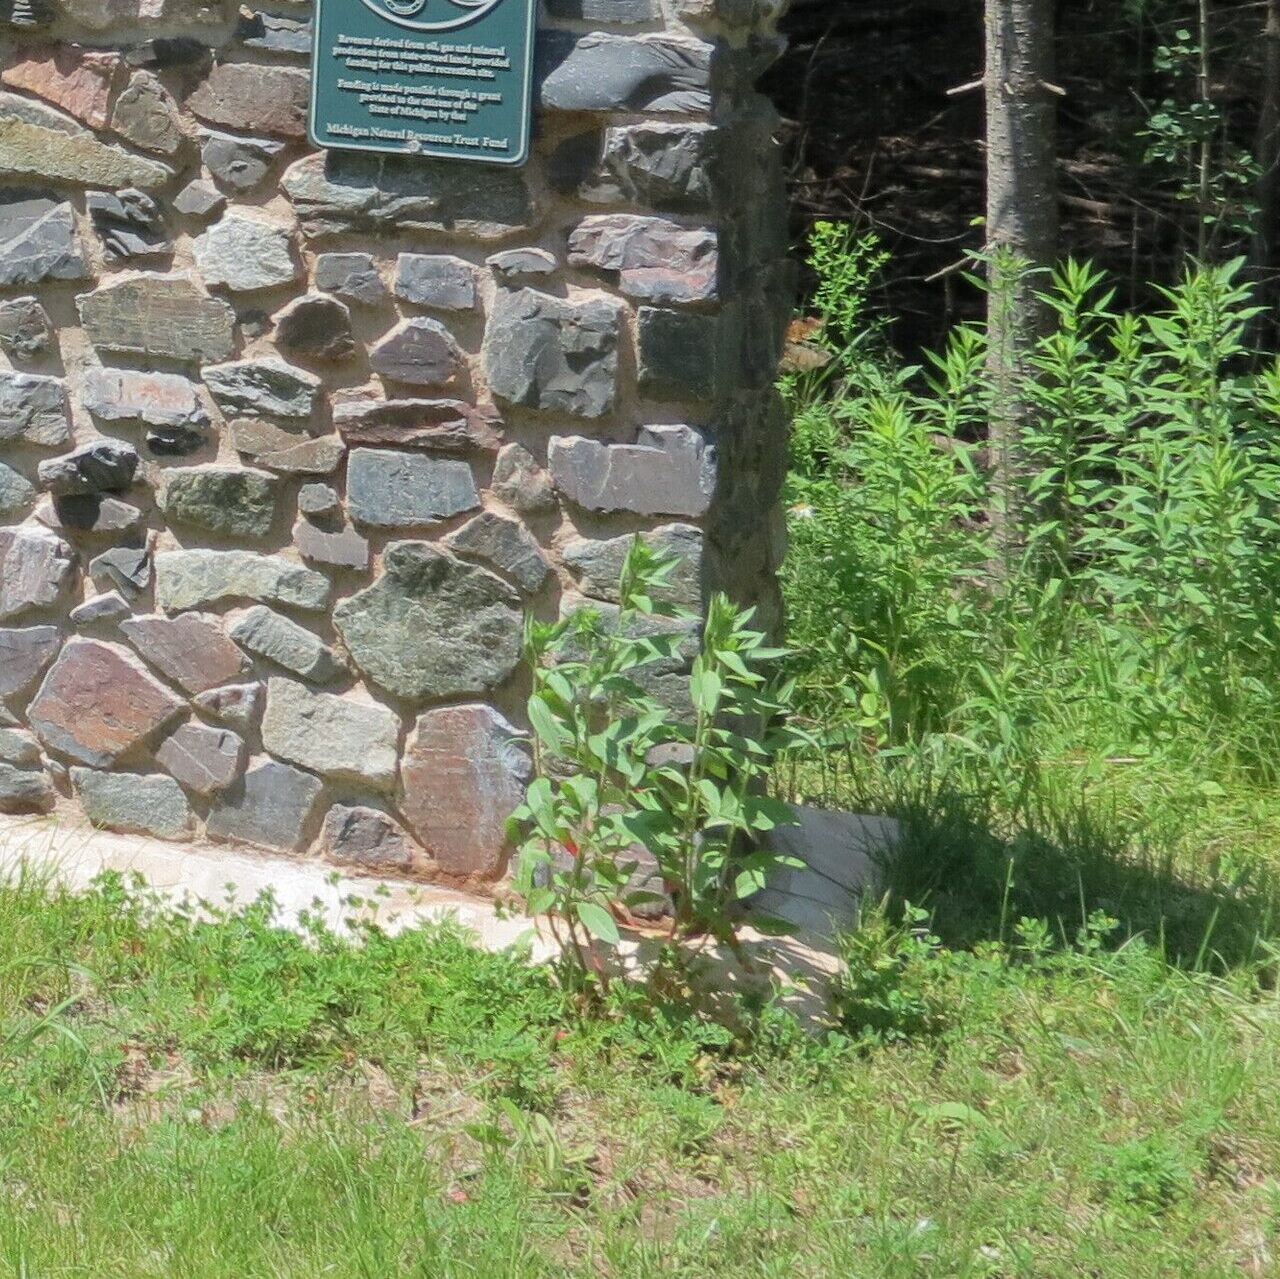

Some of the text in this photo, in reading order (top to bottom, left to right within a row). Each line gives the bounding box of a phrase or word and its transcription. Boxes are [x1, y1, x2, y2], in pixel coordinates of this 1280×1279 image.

[368, 104, 390, 114] State
[401, 106, 438, 120] Michigan
[326, 123, 508, 149] Michigan Natural Resources Trust Fund
